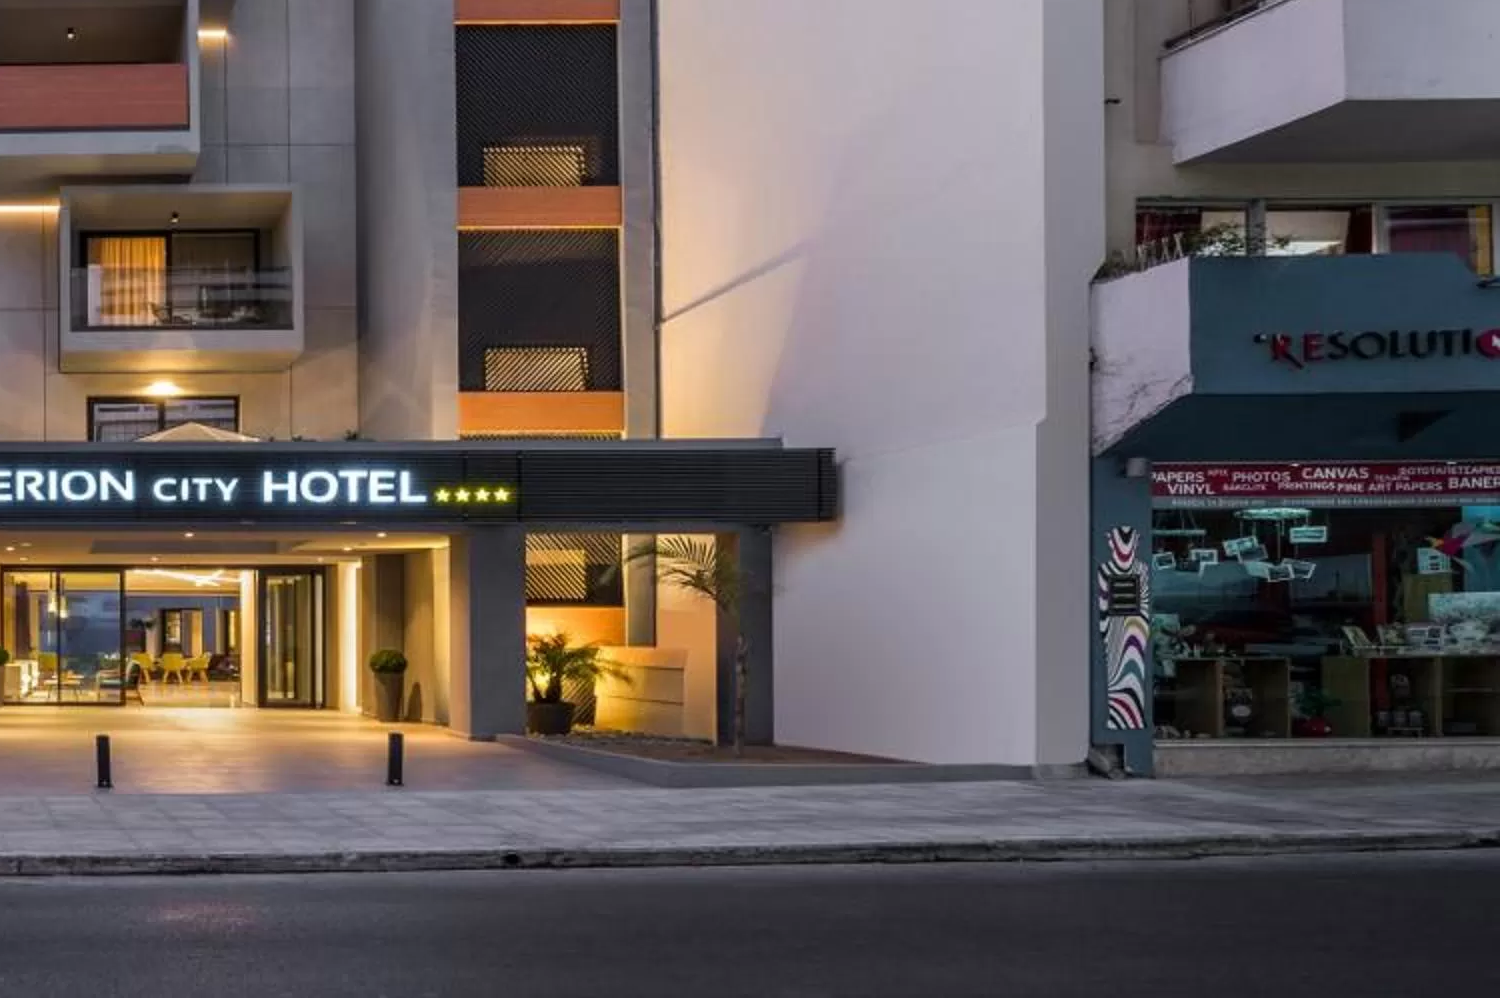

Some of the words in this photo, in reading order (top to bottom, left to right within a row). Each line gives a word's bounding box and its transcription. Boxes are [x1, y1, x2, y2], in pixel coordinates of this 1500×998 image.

[1233, 471, 1292, 483] PHOTOS
[1302, 466, 1370, 480] CANVAS
[152, 477, 239, 502] CITY
[262, 469, 428, 503] HOTEL
[1167, 483, 1216, 495] VINYL
[1337, 482, 1365, 492] FINE
[1368, 482, 1392, 492] ART
[1395, 481, 1443, 492] PAPERS
